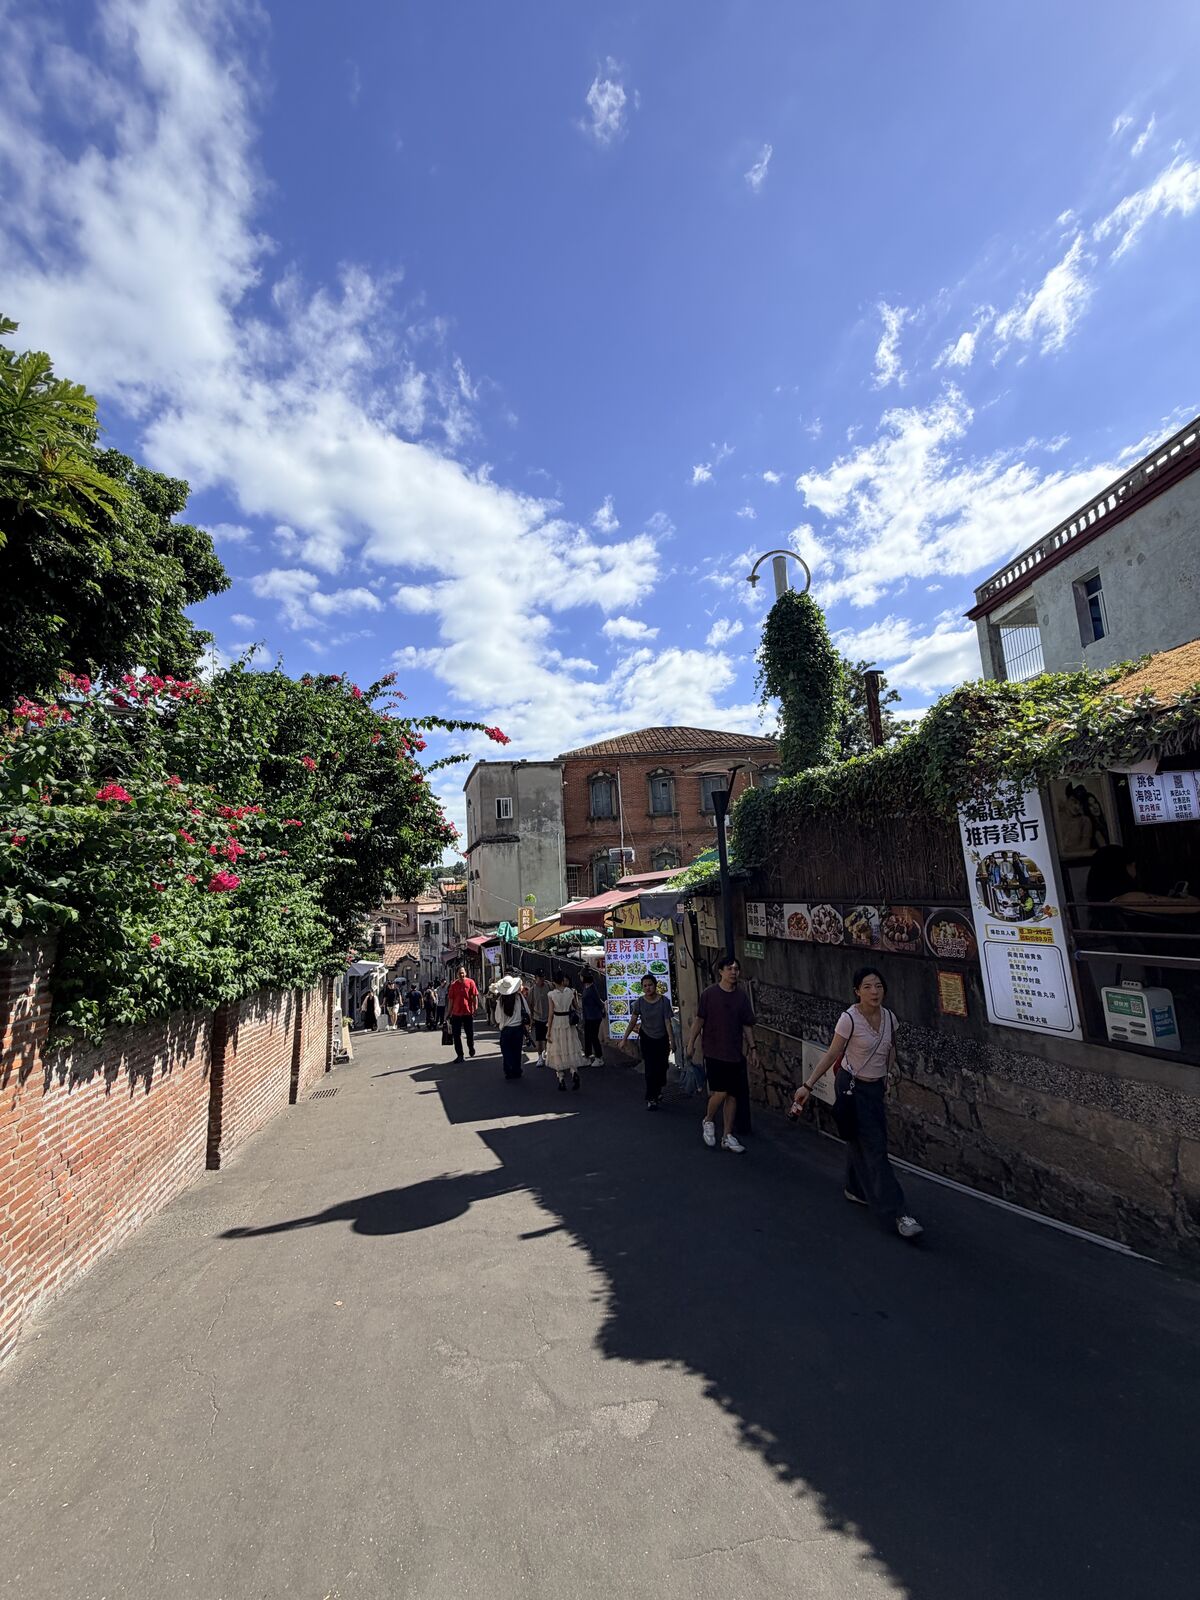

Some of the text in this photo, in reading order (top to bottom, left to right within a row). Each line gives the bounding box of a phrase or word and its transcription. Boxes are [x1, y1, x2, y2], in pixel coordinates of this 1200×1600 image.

[1136, 775, 1155, 788] 挑食
[1135, 789, 1162, 803] 海隐记
[965, 820, 1039, 847] 推荐餐厅
[606, 939, 660, 954] 庭院餐厅
[606, 952, 631, 961] 家常小炒
